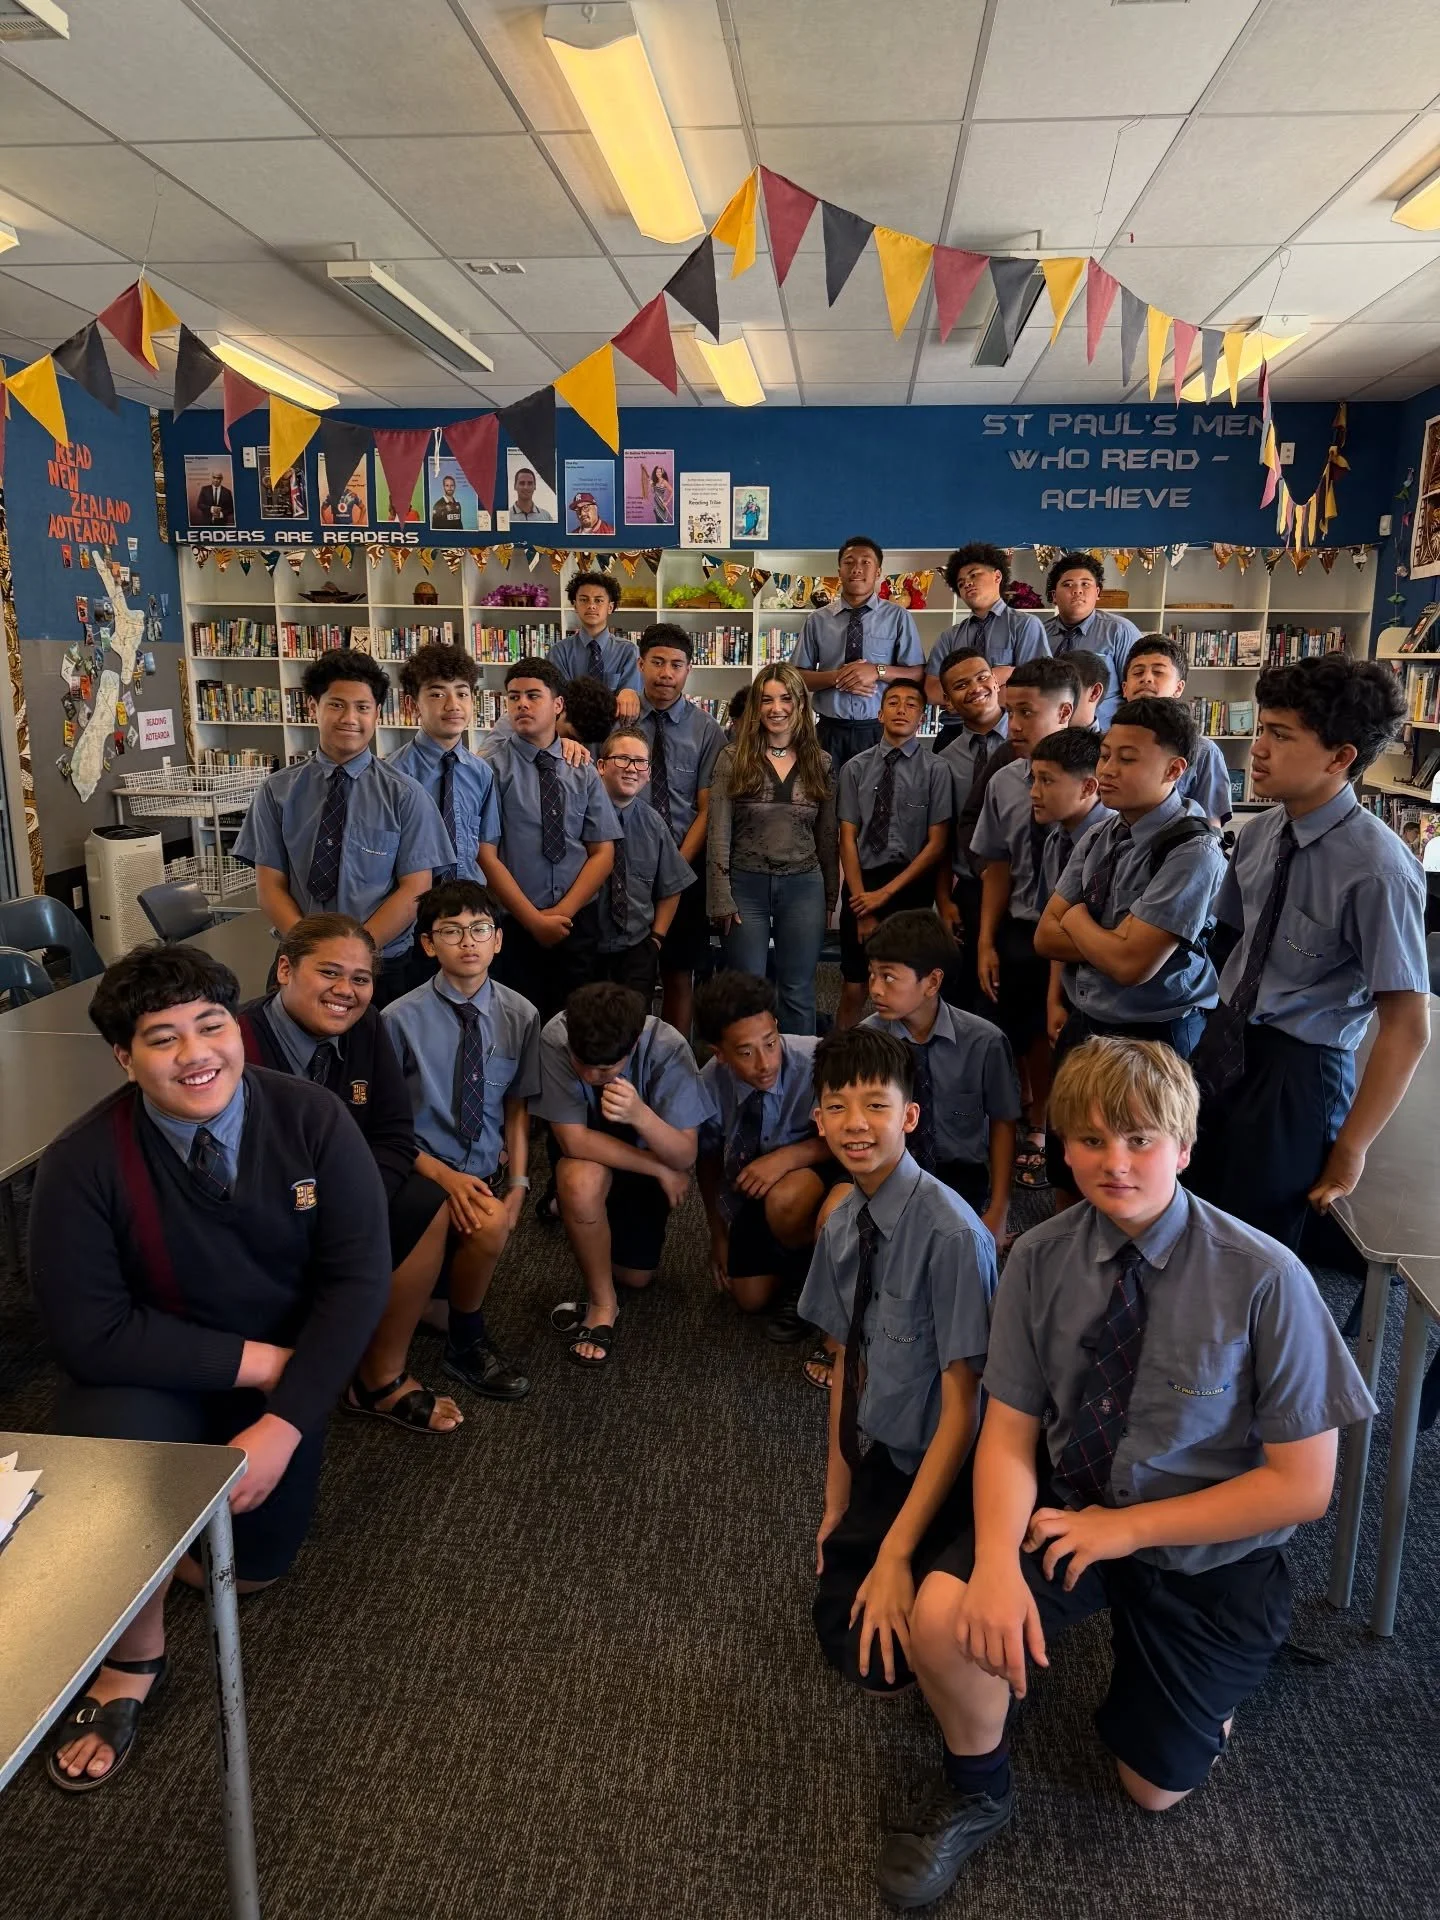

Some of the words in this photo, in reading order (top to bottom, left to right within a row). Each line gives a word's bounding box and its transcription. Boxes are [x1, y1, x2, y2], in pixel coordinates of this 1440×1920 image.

[982, 414, 1033, 437] ST
[1049, 412, 1177, 437] PAUL'S
[1192, 414, 1264, 437] MEN
[55, 440, 92, 470] READ
[1008, 446, 1090, 470] WHO
[1101, 449, 1200, 471] READ
[48, 460, 78, 492] NEW
[69, 491, 131, 524] ZEALAND
[1040, 485, 1192, 511] ACHIEVE
[48, 513, 119, 546] AOTEAROA
[175, 530, 266, 542] LEADERS
[275, 531, 314, 543] ARE
[323, 531, 419, 544] READERS
[146, 716, 167, 726] READING
[145, 731, 170, 741] AOTEAROA
